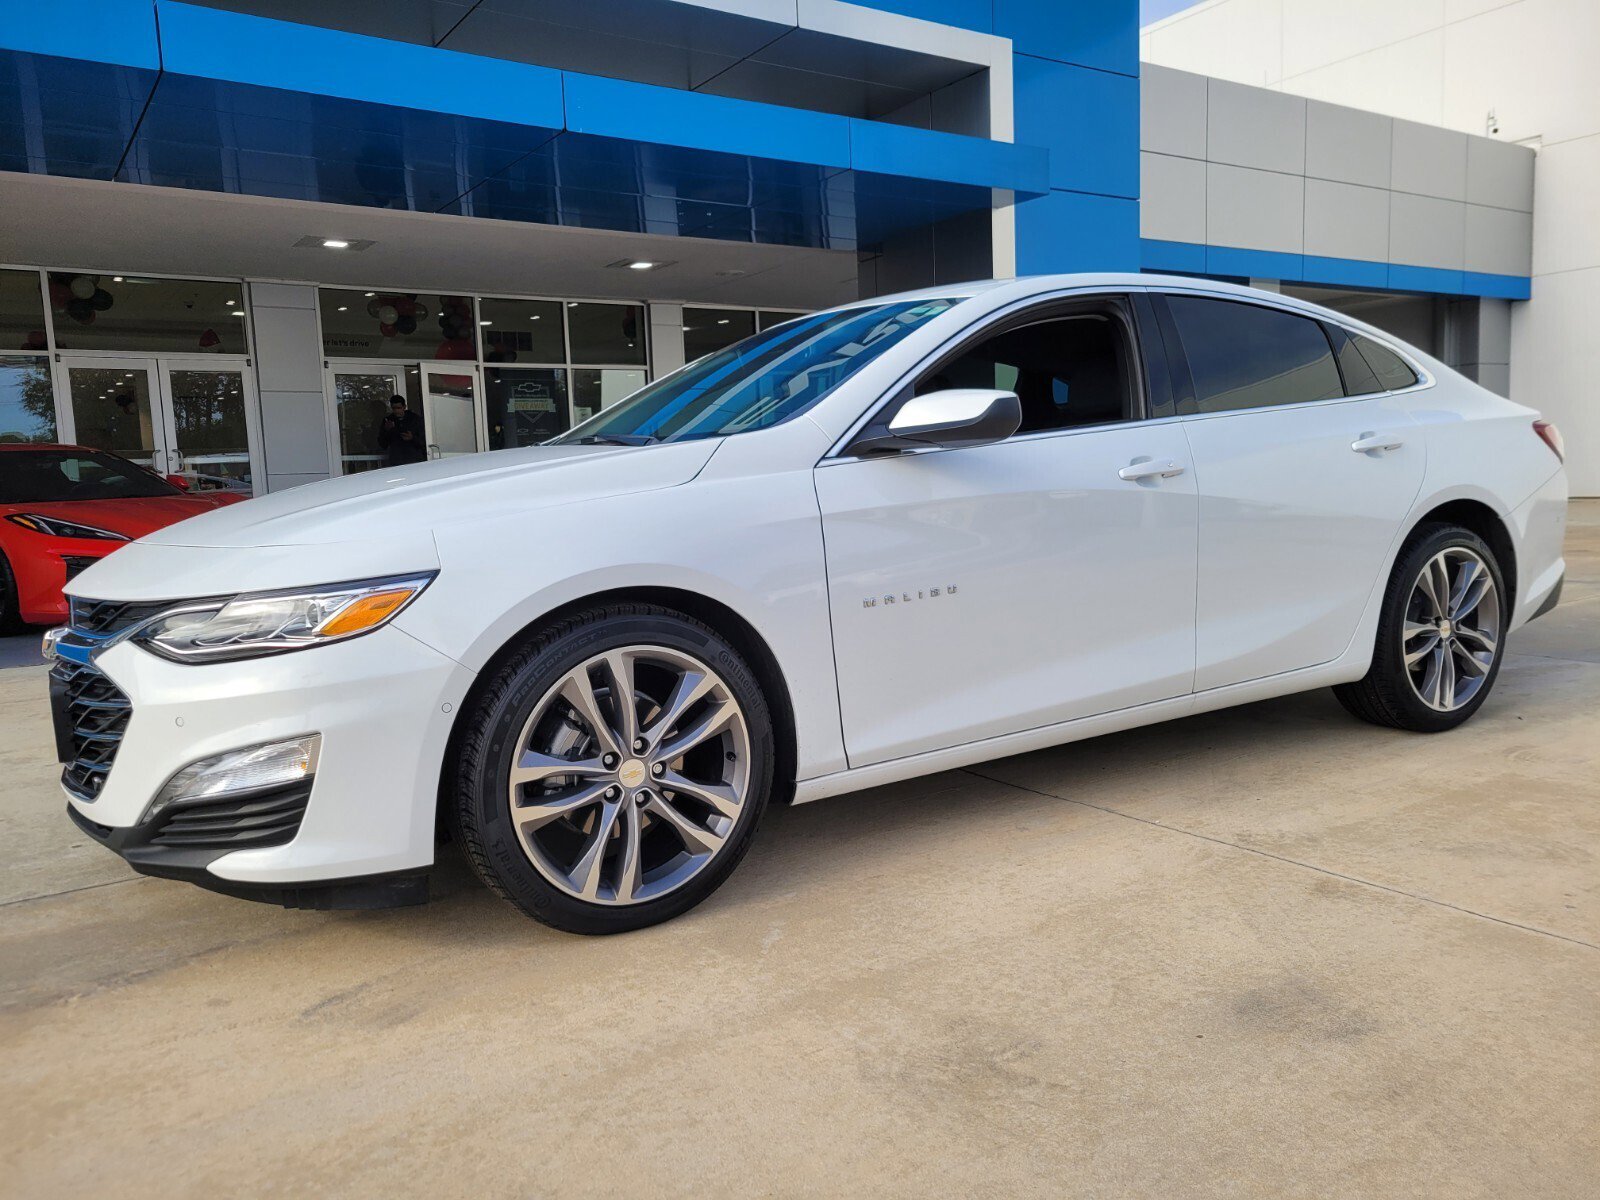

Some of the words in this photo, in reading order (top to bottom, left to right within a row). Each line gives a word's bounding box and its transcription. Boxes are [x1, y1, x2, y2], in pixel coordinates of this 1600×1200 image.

[349, 339, 370, 348] drive
[514, 402, 549, 410] GIVEAWAY
[862, 584, 958, 609] MALIBU
[718, 649, 762, 710] Continental
